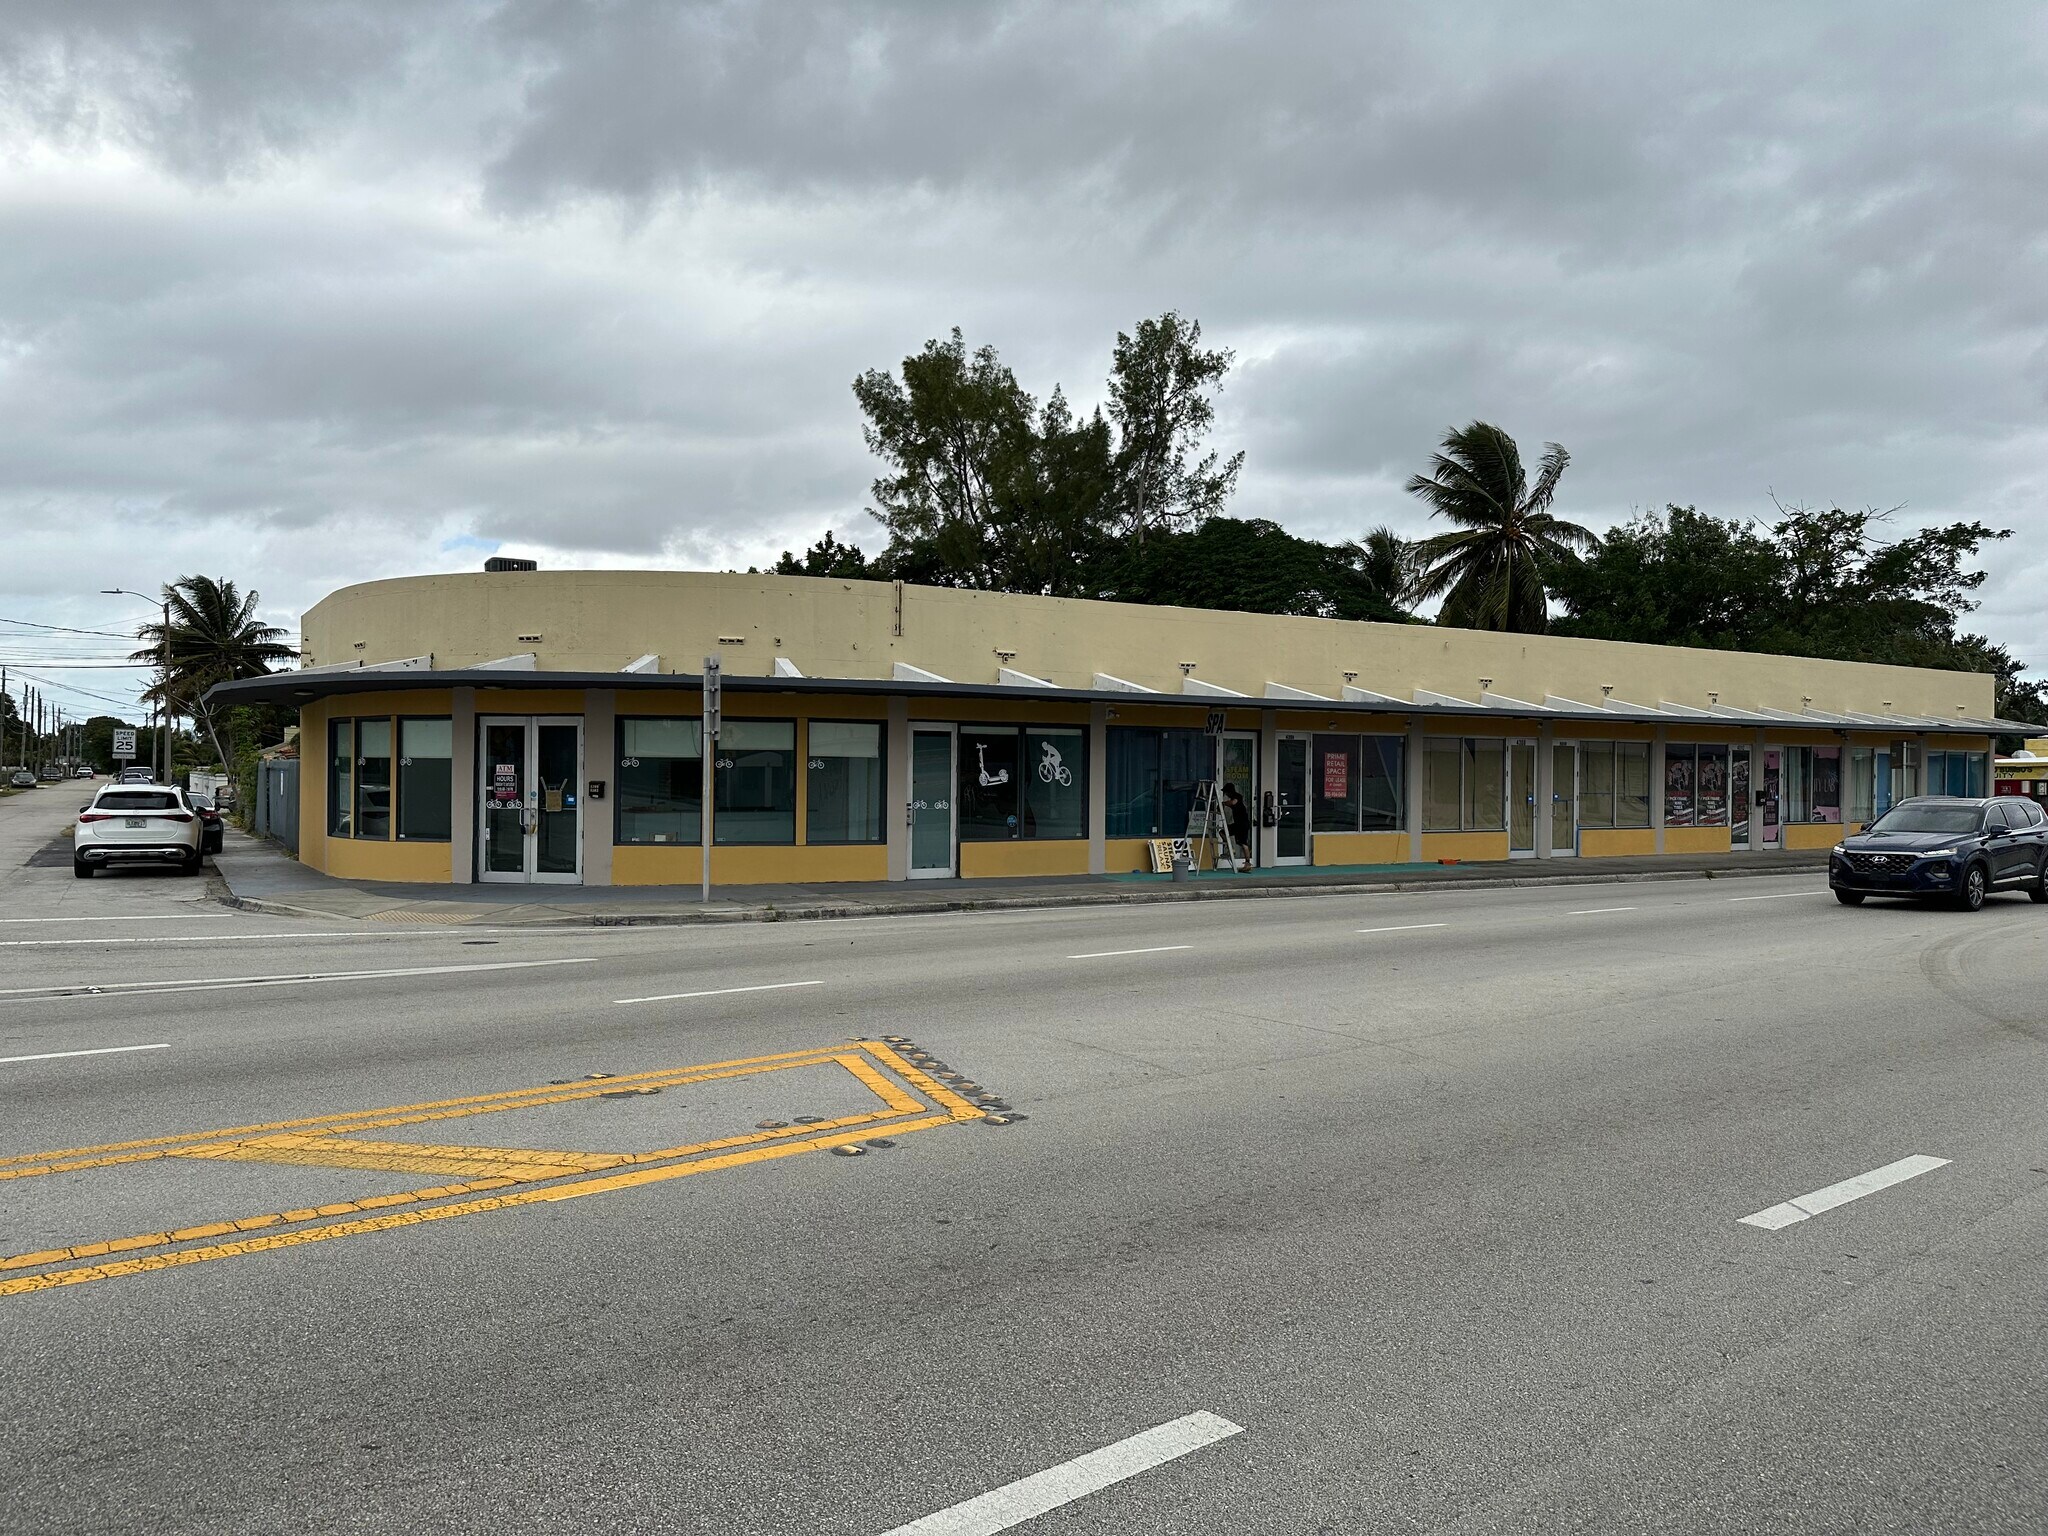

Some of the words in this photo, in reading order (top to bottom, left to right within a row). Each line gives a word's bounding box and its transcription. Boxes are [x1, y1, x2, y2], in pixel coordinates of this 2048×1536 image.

[1205, 713, 1224, 733] SPA
[115, 741, 134, 750] 25
[1162, 841, 1171, 870] SAUNA
